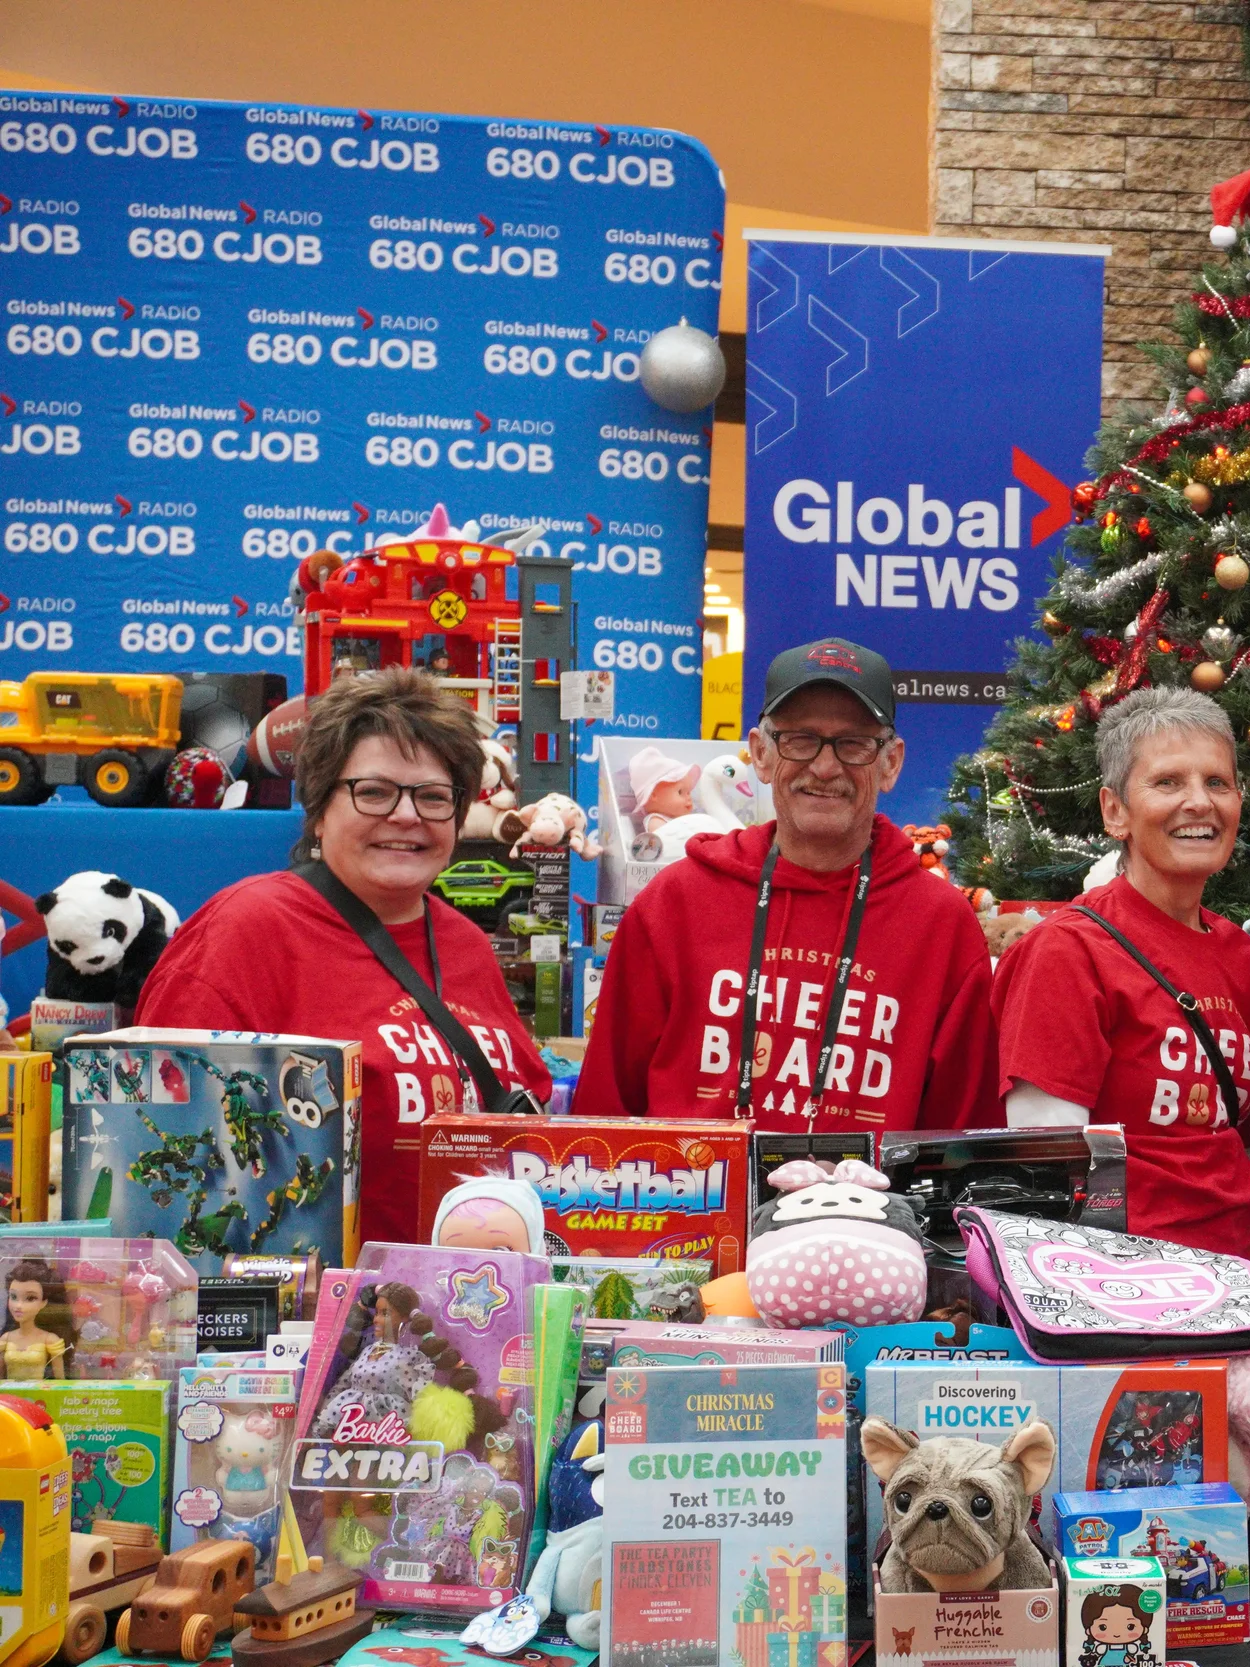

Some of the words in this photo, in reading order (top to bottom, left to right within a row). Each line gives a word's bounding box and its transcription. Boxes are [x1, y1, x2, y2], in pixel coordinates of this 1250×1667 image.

[0, 97, 59, 114] Global
[61, 100, 110, 116] News
[137, 103, 198, 120] RADIO
[1, 121, 77, 155] 680
[86, 124, 199, 160] CJOB
[487, 123, 544, 140] Global
[546, 126, 593, 144] News
[618, 132, 675, 149] RADIO
[487, 147, 560, 181] 680
[569, 152, 676, 188] CJOB
[128, 203, 188, 220] Global
[190, 205, 238, 223] News
[263, 209, 323, 227] RADIO
[128, 227, 205, 261] 680
[213, 231, 323, 266] CJOB
[7, 300, 66, 317] Global
[68, 302, 116, 319] News
[142, 304, 201, 322] RADIO
[7, 324, 83, 357] 680
[91, 326, 201, 360] CJOB
[6, 499, 63, 514] Global
[65, 500, 113, 516] News
[138, 502, 197, 518] RADIO
[773, 479, 1020, 549] Global
[5, 523, 78, 554] 680
[88, 524, 196, 556] CJOB
[835, 554, 1020, 611] NEWS
[594, 616, 647, 632] Global
[649, 620, 694, 637] News
[593, 638, 663, 672] 680
[55, 694, 72, 705] CAT
[36, 1004, 72, 1019] NANCY
[74, 1005, 107, 1020] DREW
[709, 969, 900, 1044] CHEER
[824, 1105, 851, 1116] 1919
[451, 1134, 492, 1143] WARNING:
[510, 1151, 729, 1217] Basketball
[566, 1214, 627, 1231] GAME
[632, 1215, 668, 1231] SET
[664, 1245, 681, 1259] TO
[683, 1236, 715, 1255] PLAY
[1024, 1293, 1068, 1307] SQUAD
[198, 1314, 248, 1324] ECKERS
[972, 1327, 983, 1335] 5+
[686, 1393, 775, 1412] CHRISTMAS
[938, 1385, 1017, 1400] Discovering
[59, 1407, 99, 1417] jewelry
[102, 1406, 122, 1415] tree
[610, 1415, 642, 1424] CHEER
[924, 1405, 1032, 1428] HOCKEY
[332, 1403, 412, 1445] Barbie
[610, 1425, 642, 1433] BOARD
[696, 1414, 764, 1432] MIRACLE
[301, 1448, 431, 1482] EXTRA
[628, 1450, 822, 1481] GIVEAWAY
[670, 1492, 708, 1508] Text
[713, 1487, 758, 1507] TEA
[763, 1488, 786, 1506] to
[662, 1511, 794, 1530] 204-837-3449
[1066, 1522, 1116, 1543] PAW
[619, 1548, 642, 1560] THE
[647, 1547, 669, 1560] TEA
[673, 1546, 712, 1559] PARTY
[935, 1604, 1003, 1626] Huggable
[1168, 1607, 1188, 1617] FIRE
[1194, 1605, 1224, 1615] RESCUE
[934, 1620, 1005, 1641] Frenchie
